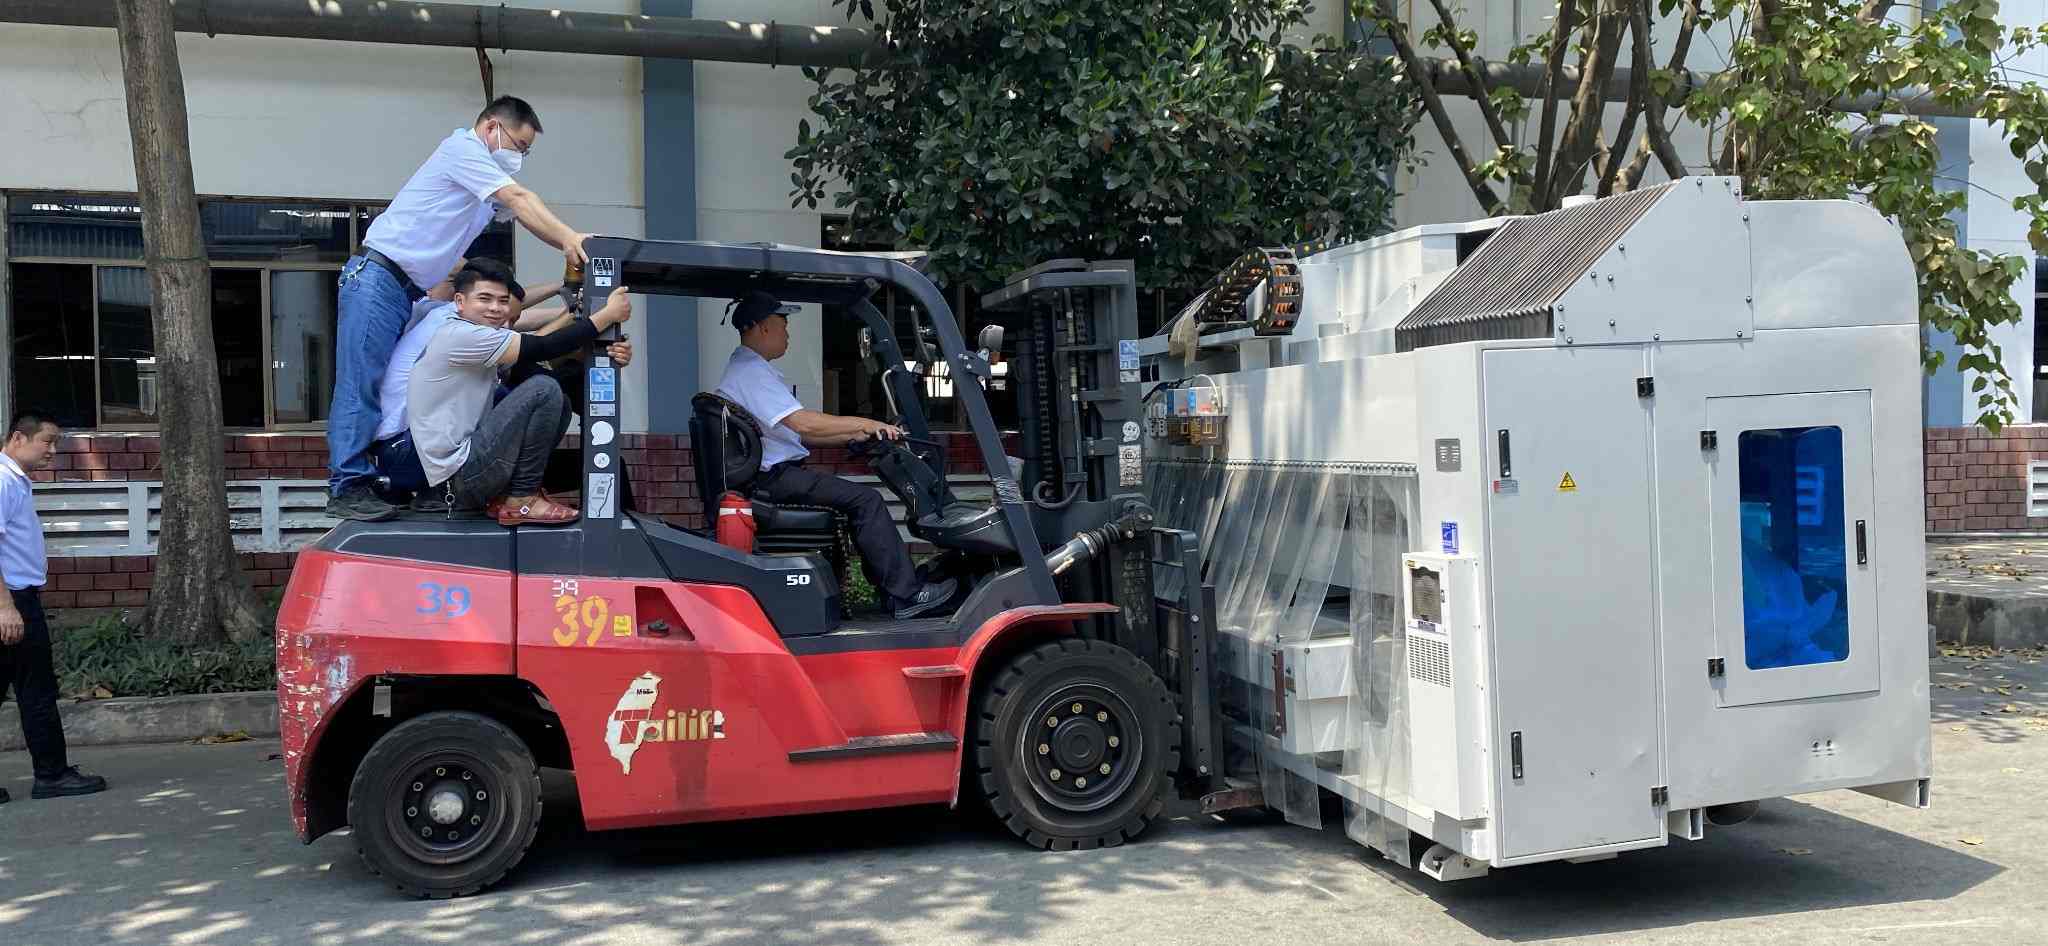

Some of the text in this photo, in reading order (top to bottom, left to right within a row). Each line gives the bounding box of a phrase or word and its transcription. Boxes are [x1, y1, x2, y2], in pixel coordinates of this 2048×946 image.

[553, 579, 578, 597] 39
[786, 574, 811, 586] 50
[416, 582, 472, 617] 39
[553, 594, 609, 647] 39
